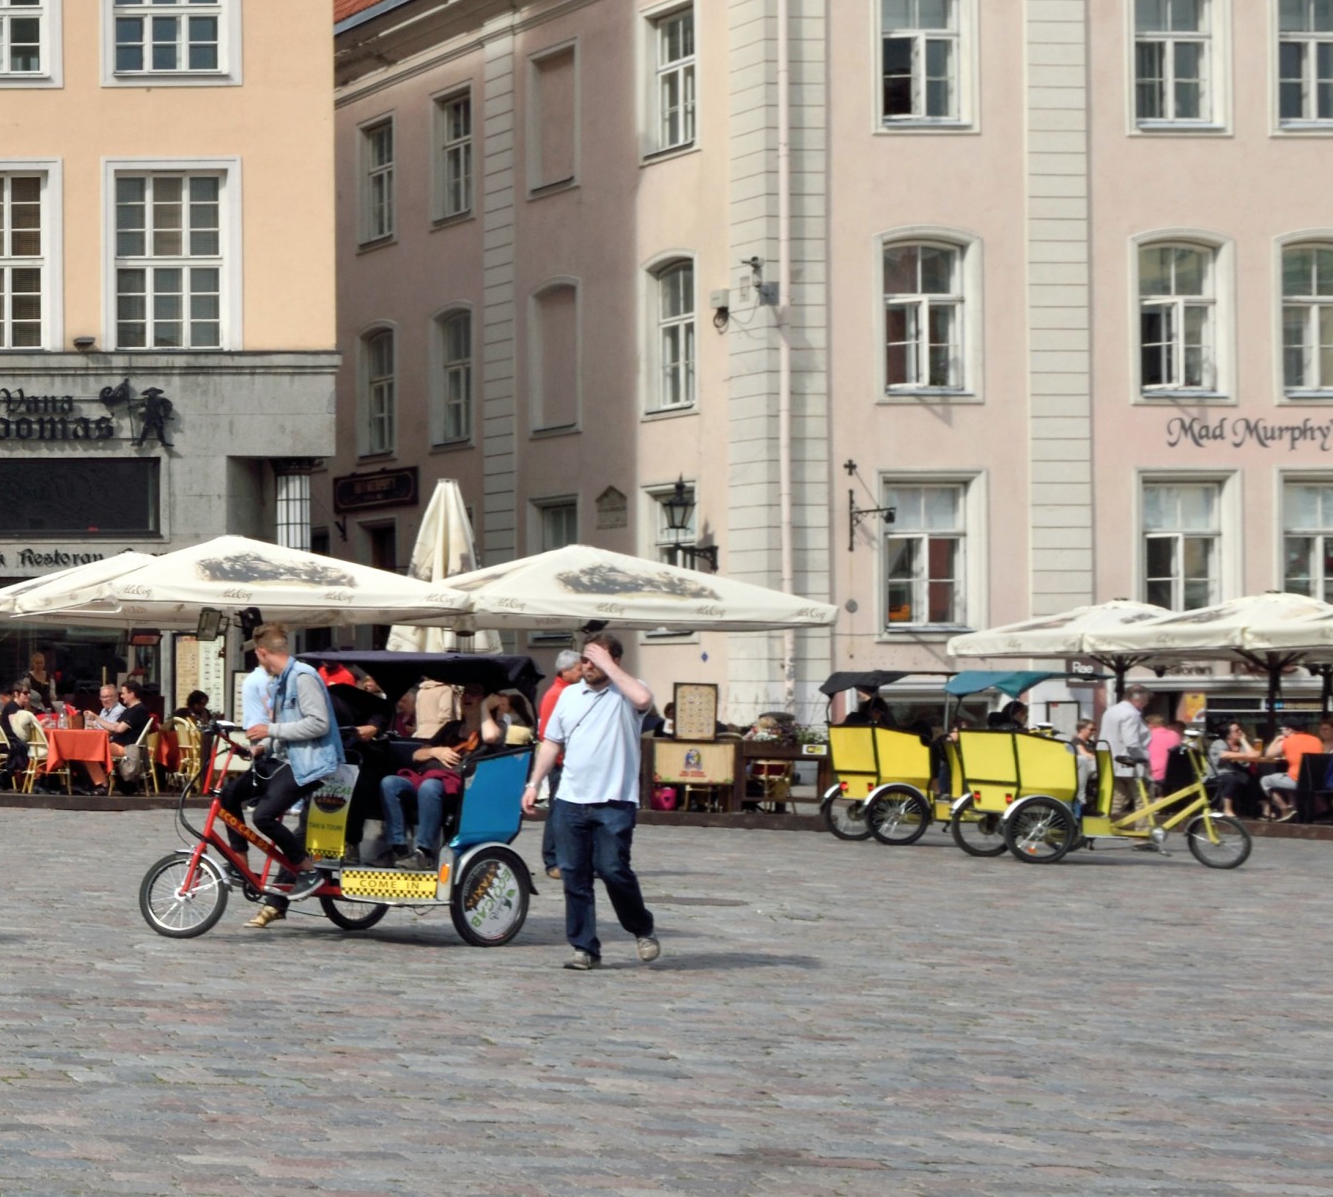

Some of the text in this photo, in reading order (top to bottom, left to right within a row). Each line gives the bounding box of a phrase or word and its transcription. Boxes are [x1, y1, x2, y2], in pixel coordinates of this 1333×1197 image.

[1167, 417, 1227, 448] Mad
[218, 808, 238, 826] ECO
[238, 823, 256, 841] CAB
[359, 879, 420, 890] COME IN
